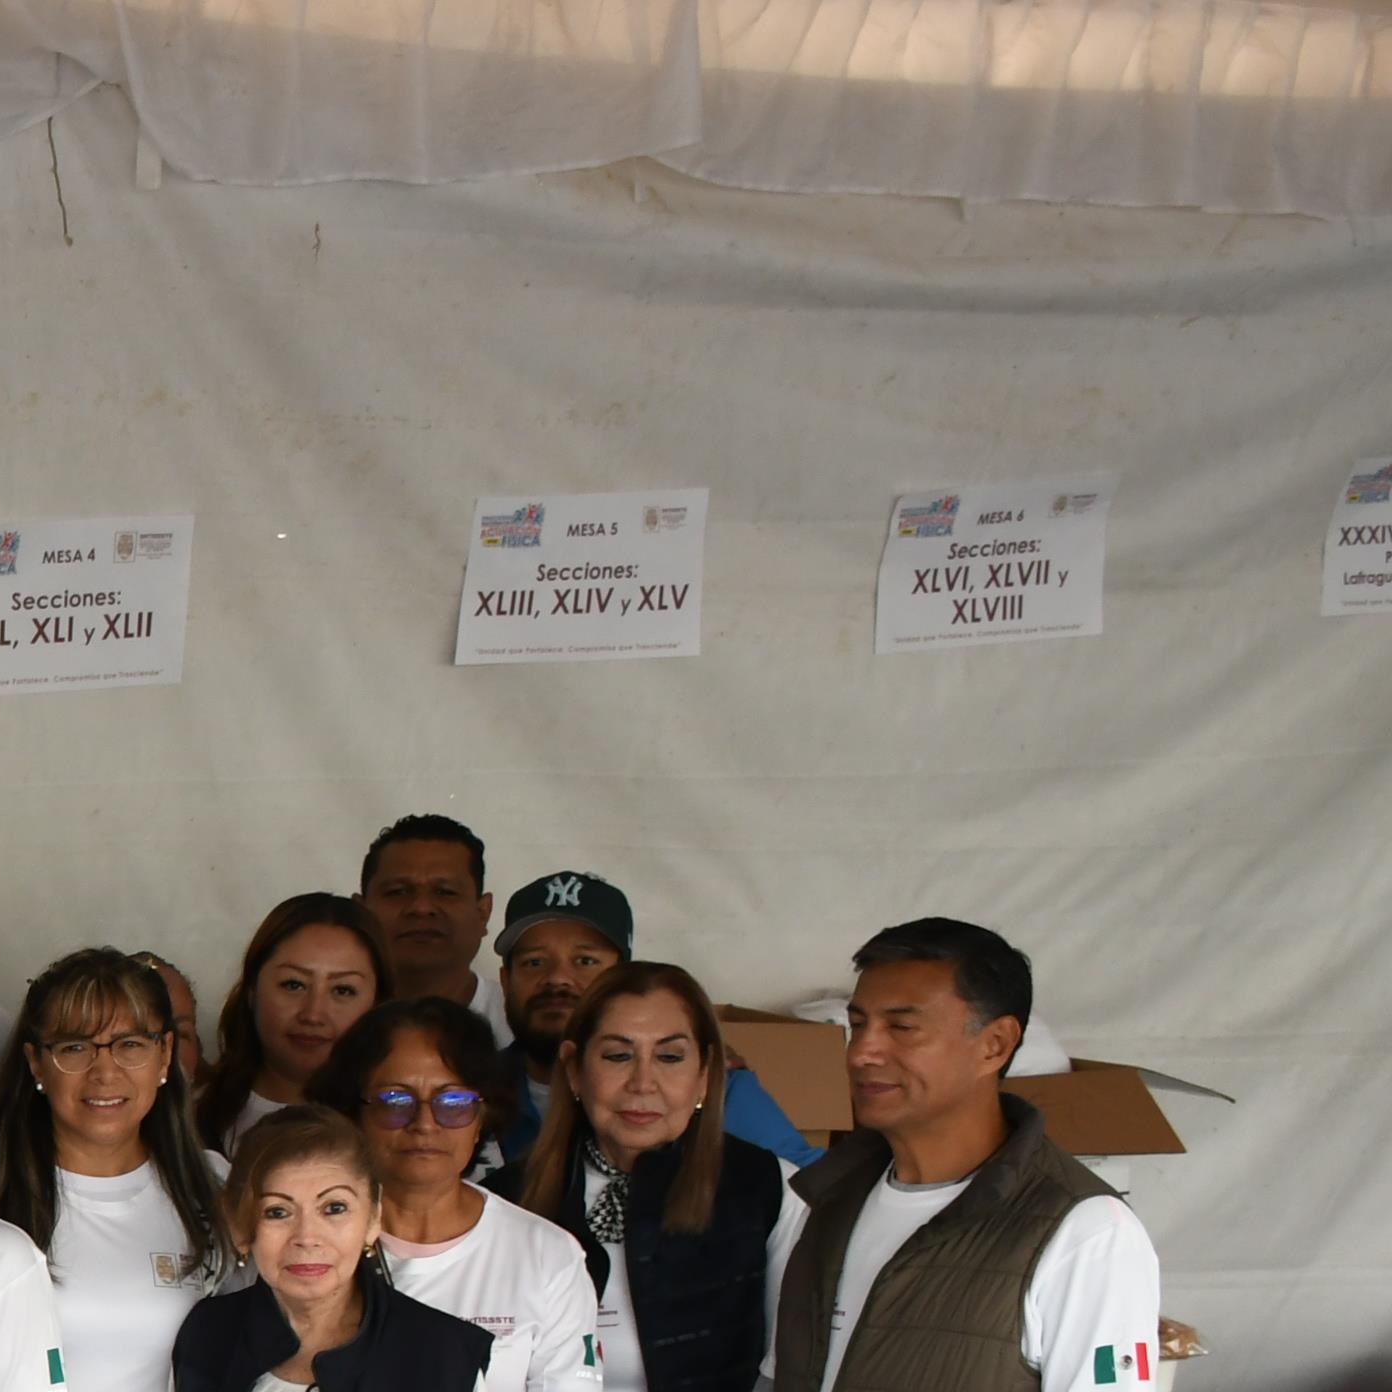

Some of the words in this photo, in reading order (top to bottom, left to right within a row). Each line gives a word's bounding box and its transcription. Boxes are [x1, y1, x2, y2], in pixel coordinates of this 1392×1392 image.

[977, 511, 1013, 525] MESA
[1017, 510, 1024, 521] 6
[567, 523, 605, 537] MESA
[610, 522, 618, 536] 5
[43, 549, 82, 564] MESA
[87, 548, 96, 562] 4
[947, 539, 1042, 560] Secciones:
[536, 562, 638, 582] Secciones:
[911, 565, 975, 595] XLVI,
[984, 560, 1050, 590] XLVII
[1058, 570, 1069, 588] y
[12, 590, 122, 611] Secciones:
[474, 590, 541, 619] XLIII,
[551, 588, 614, 615] XLIV
[621, 598, 631, 616] y
[638, 584, 689, 612] XLV
[951, 594, 1024, 625] XLVIII
[30, 617, 73, 644] XLI
[83, 628, 95, 645] y
[102, 612, 153, 641] XLII
